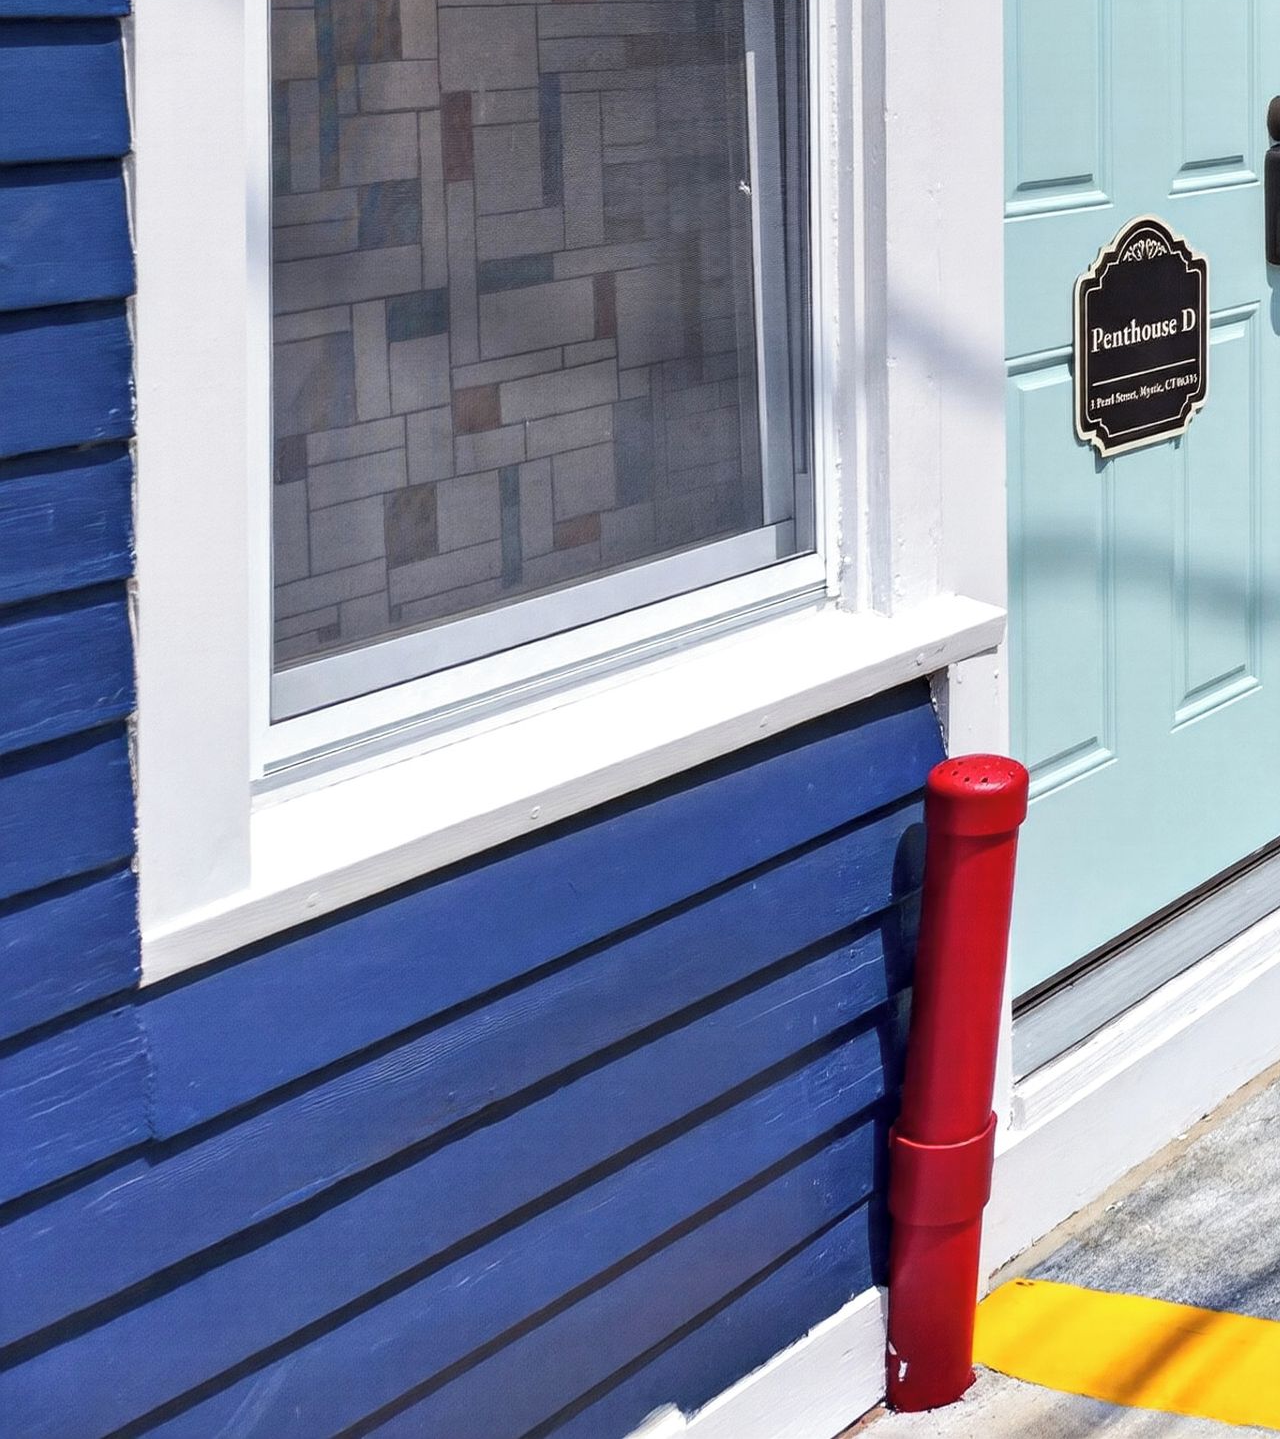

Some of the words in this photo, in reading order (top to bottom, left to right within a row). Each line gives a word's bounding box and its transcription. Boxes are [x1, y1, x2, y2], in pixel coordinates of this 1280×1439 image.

[1091, 318, 1177, 353] Penthouse
[1181, 308, 1196, 332] D
[1165, 377, 1176, 391] CT
